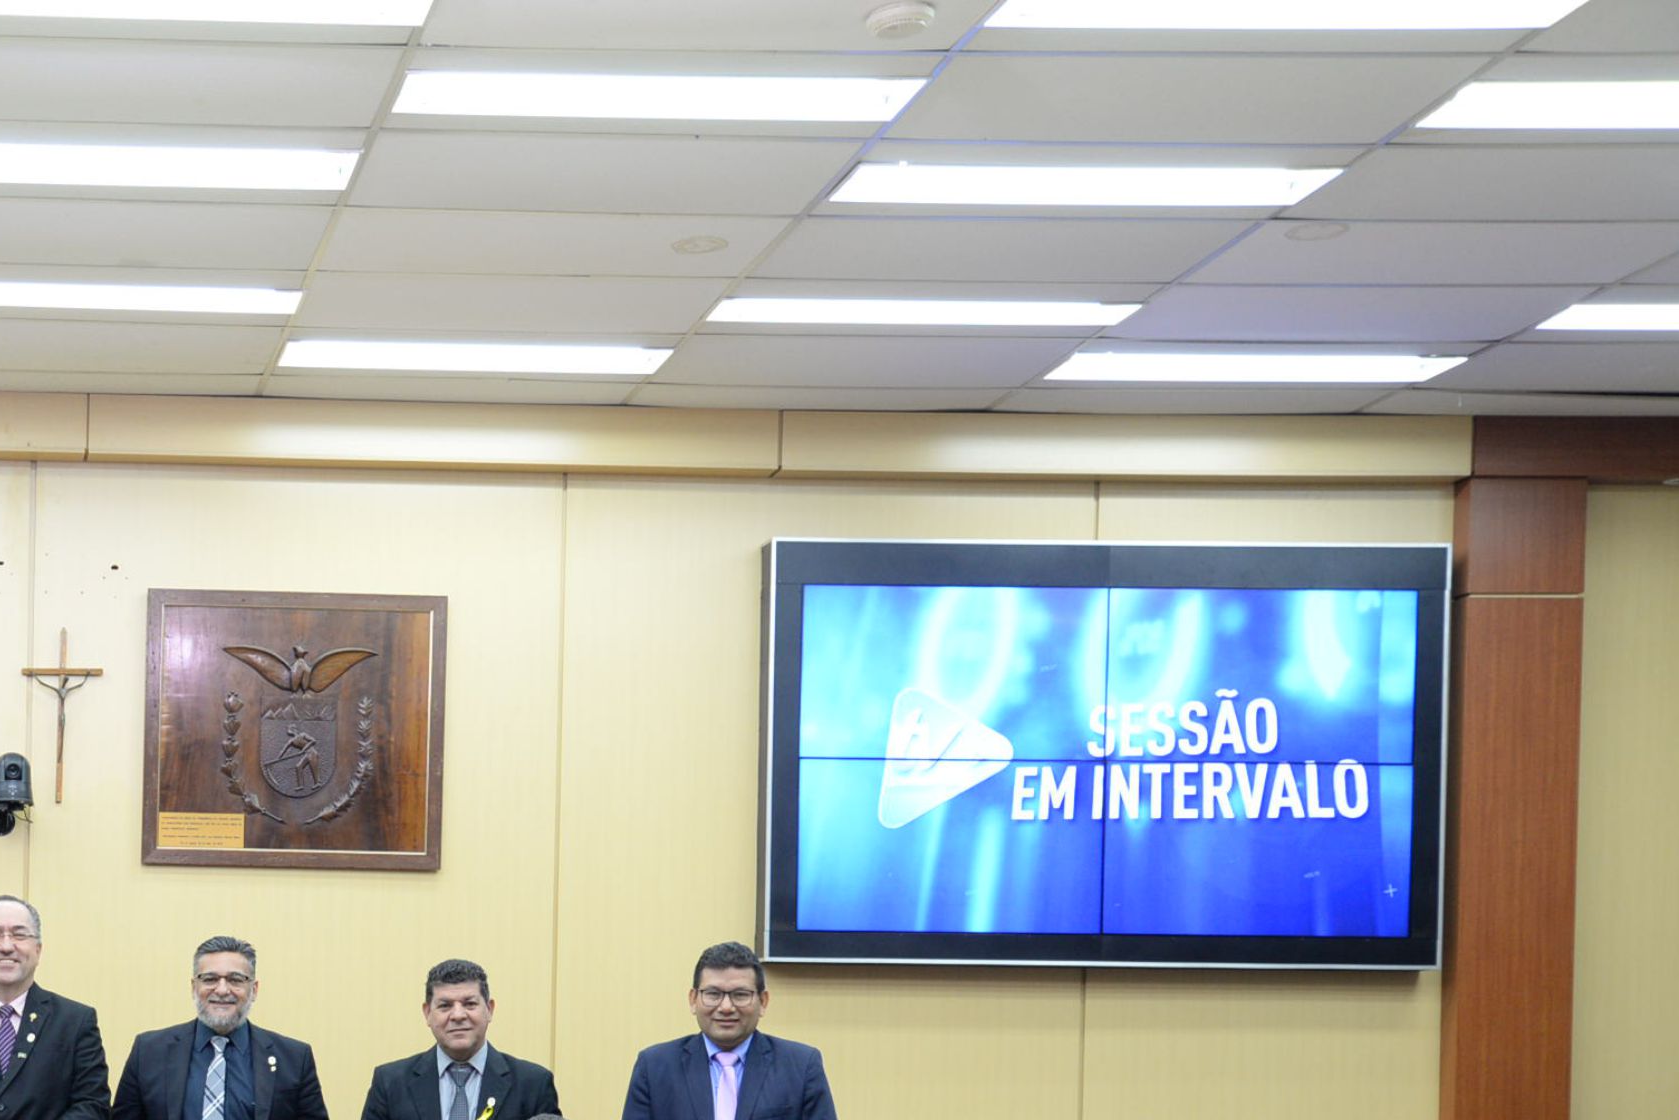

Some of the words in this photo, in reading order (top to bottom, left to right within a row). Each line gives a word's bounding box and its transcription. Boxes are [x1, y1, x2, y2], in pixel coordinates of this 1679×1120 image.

[1087, 689, 1278, 757] SESSÃO
[1011, 765, 1077, 821] EM
[1091, 759, 1369, 820] INTERVALO
